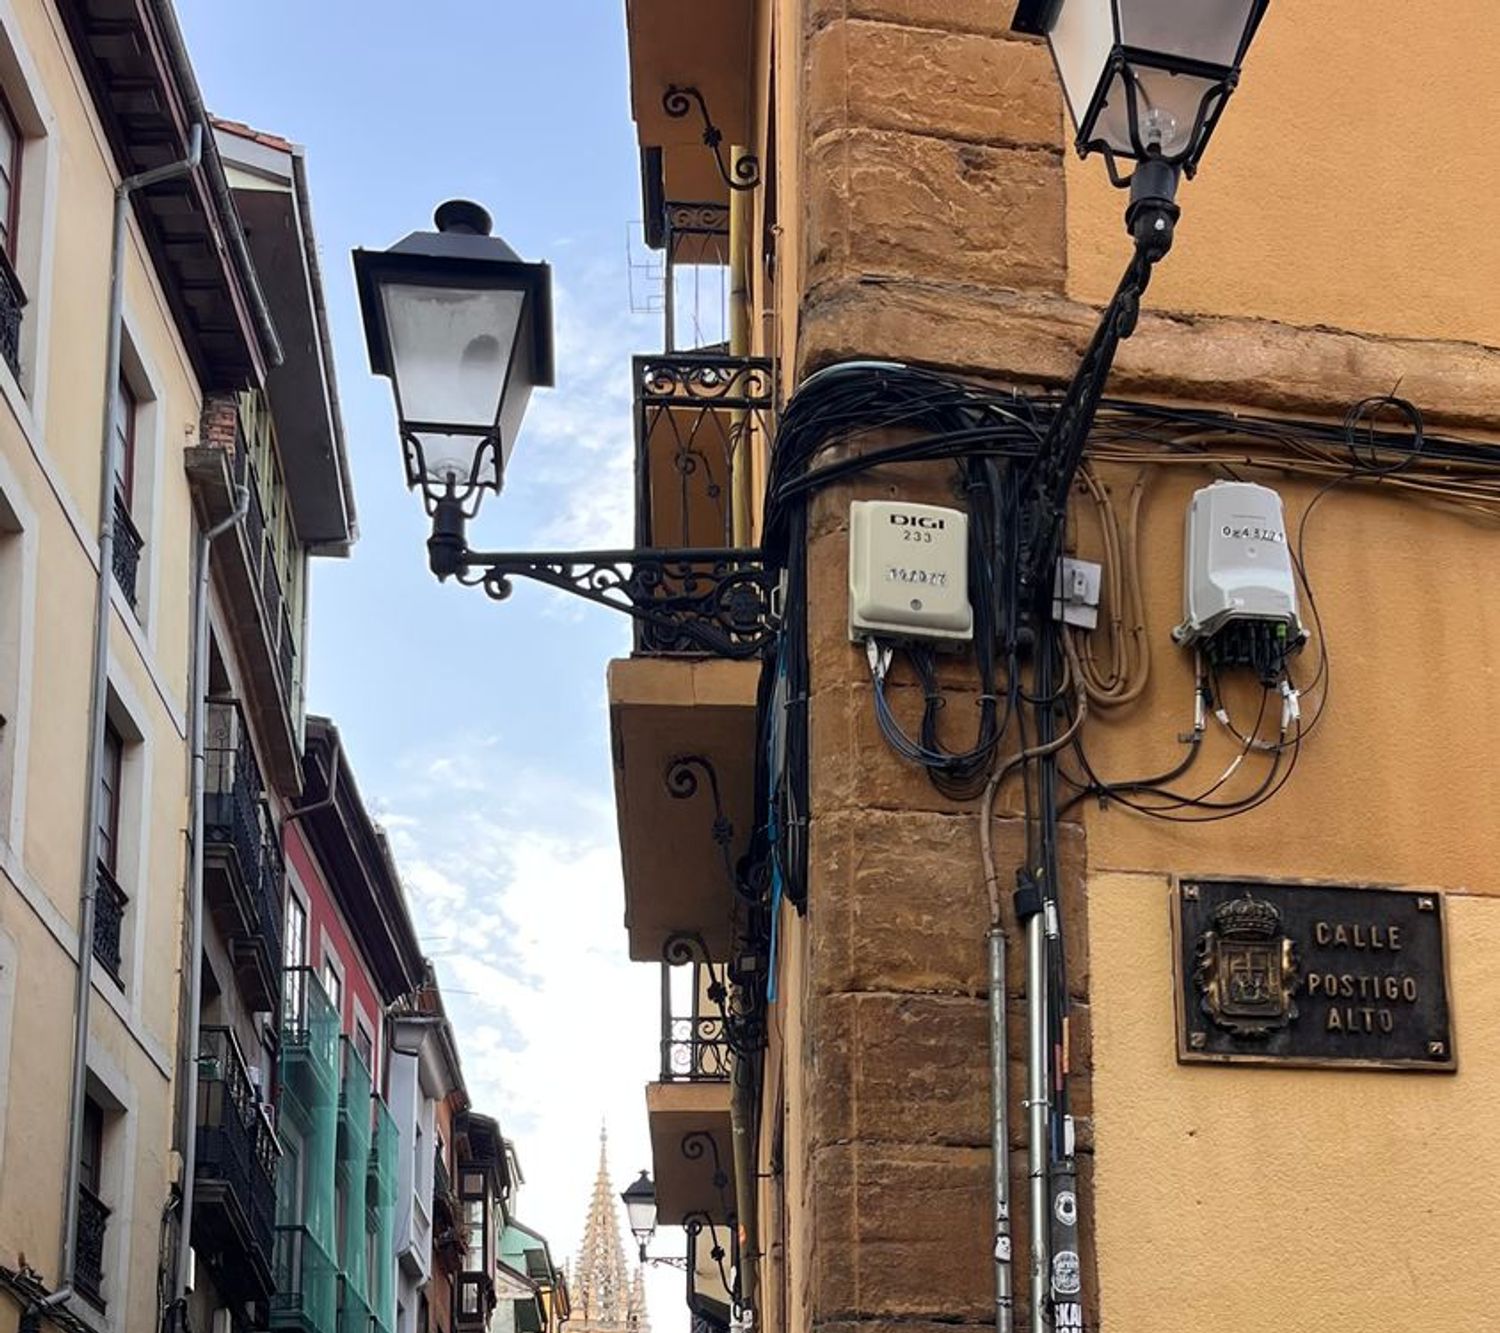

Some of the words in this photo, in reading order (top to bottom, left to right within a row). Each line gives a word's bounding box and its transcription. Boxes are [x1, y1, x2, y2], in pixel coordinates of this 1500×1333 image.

[889, 514, 945, 529] DIGI
[903, 530, 932, 543] 233
[1315, 922, 1403, 950] CALLE
[1308, 973, 1418, 1003] POSTIGO
[1327, 1007, 1394, 1034] ALTO
